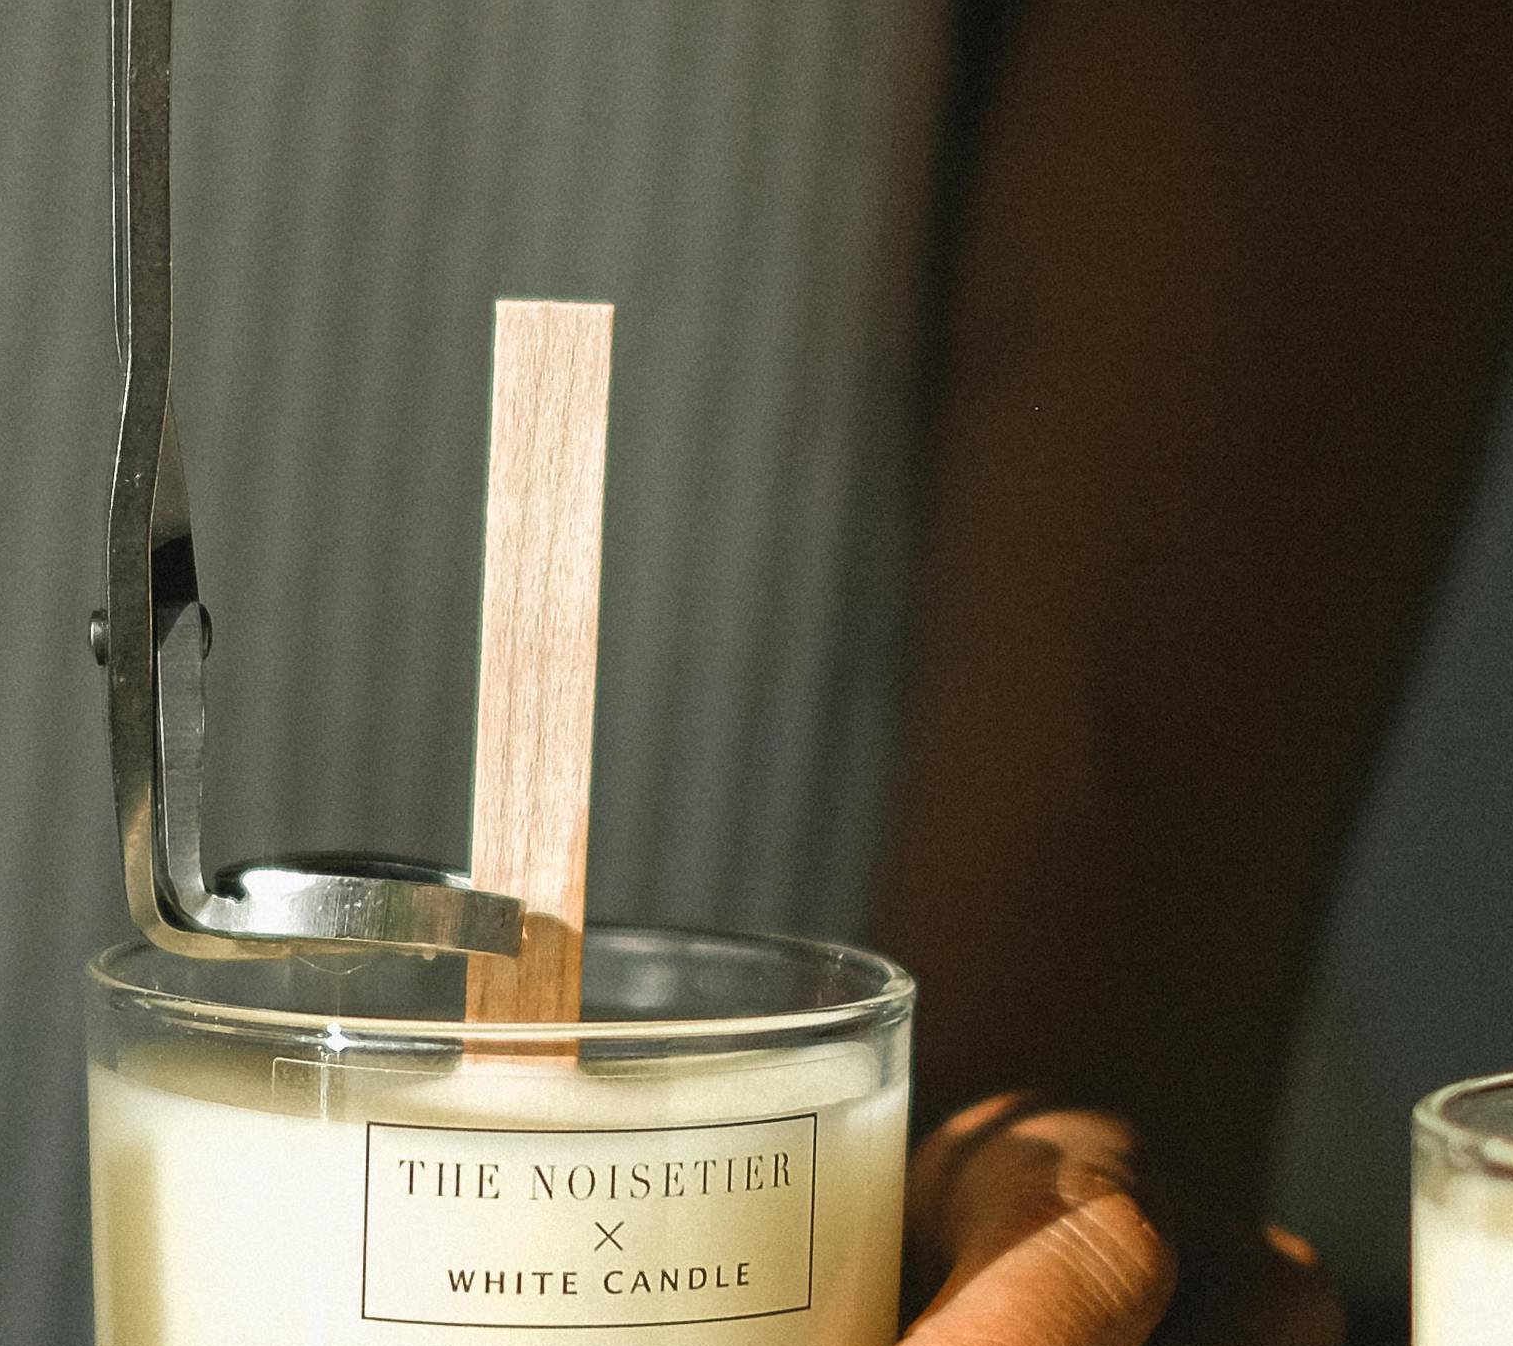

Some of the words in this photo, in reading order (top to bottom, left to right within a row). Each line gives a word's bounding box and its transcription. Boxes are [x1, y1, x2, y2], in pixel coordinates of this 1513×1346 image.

[398, 1158, 501, 1200] THE
[529, 1151, 793, 1202] NOISETIER
[447, 1268, 579, 1296] WHITE
[602, 1261, 752, 1296] CANDLE
